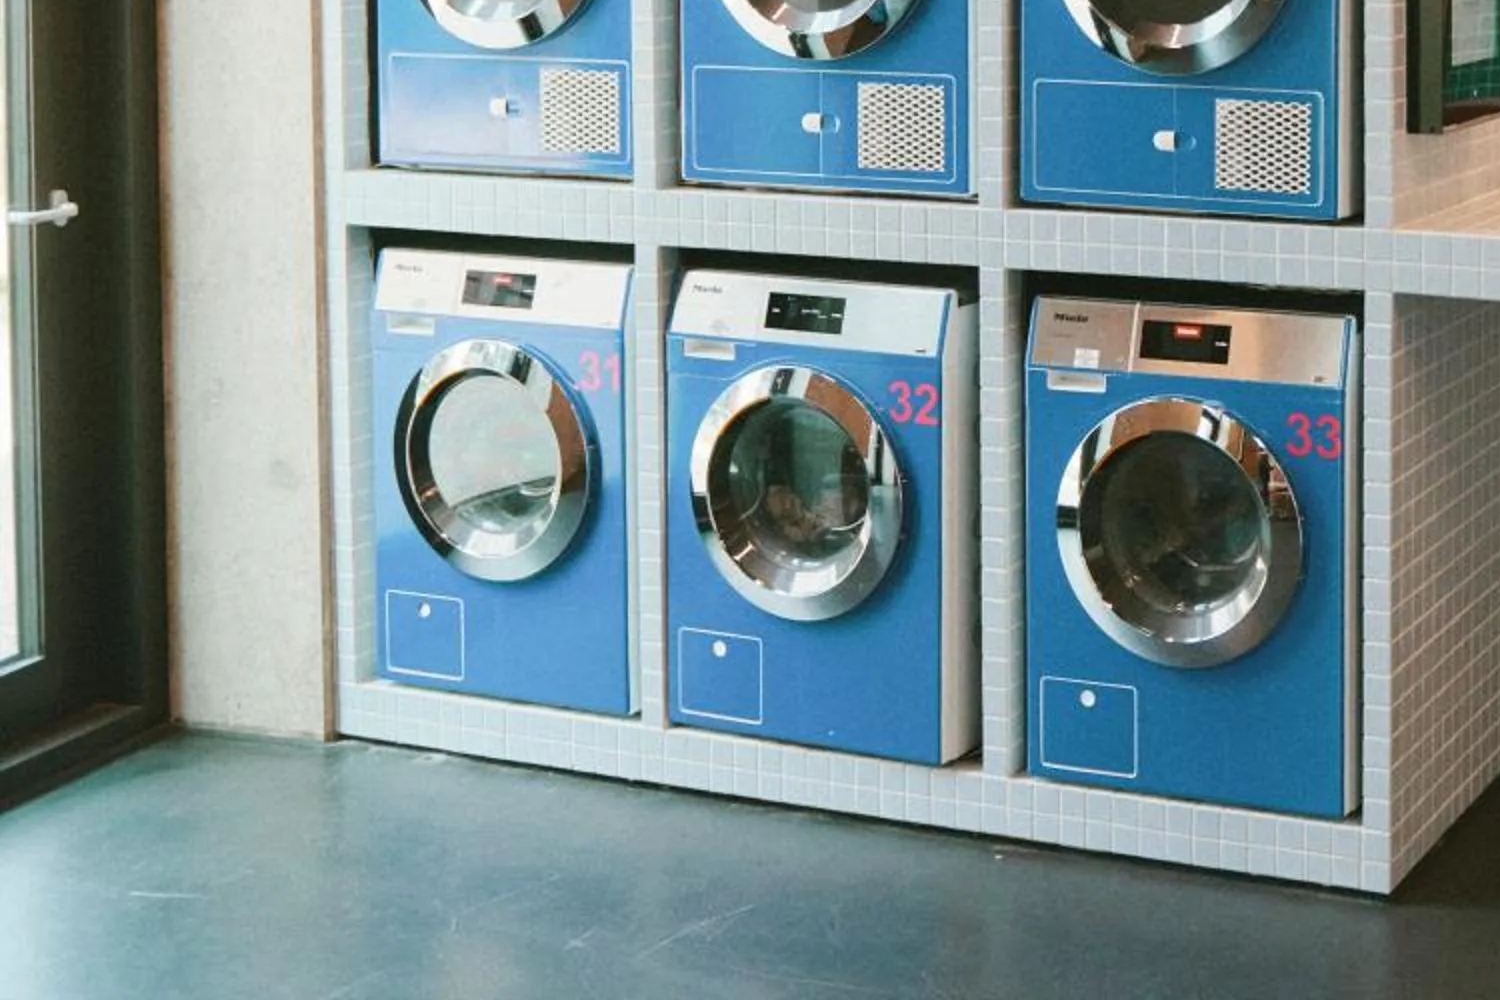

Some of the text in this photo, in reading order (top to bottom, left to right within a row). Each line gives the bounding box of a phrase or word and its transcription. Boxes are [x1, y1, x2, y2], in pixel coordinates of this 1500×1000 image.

[577, 349, 621, 392] 31
[888, 379, 939, 426] 32
[1286, 411, 1343, 460] 33
